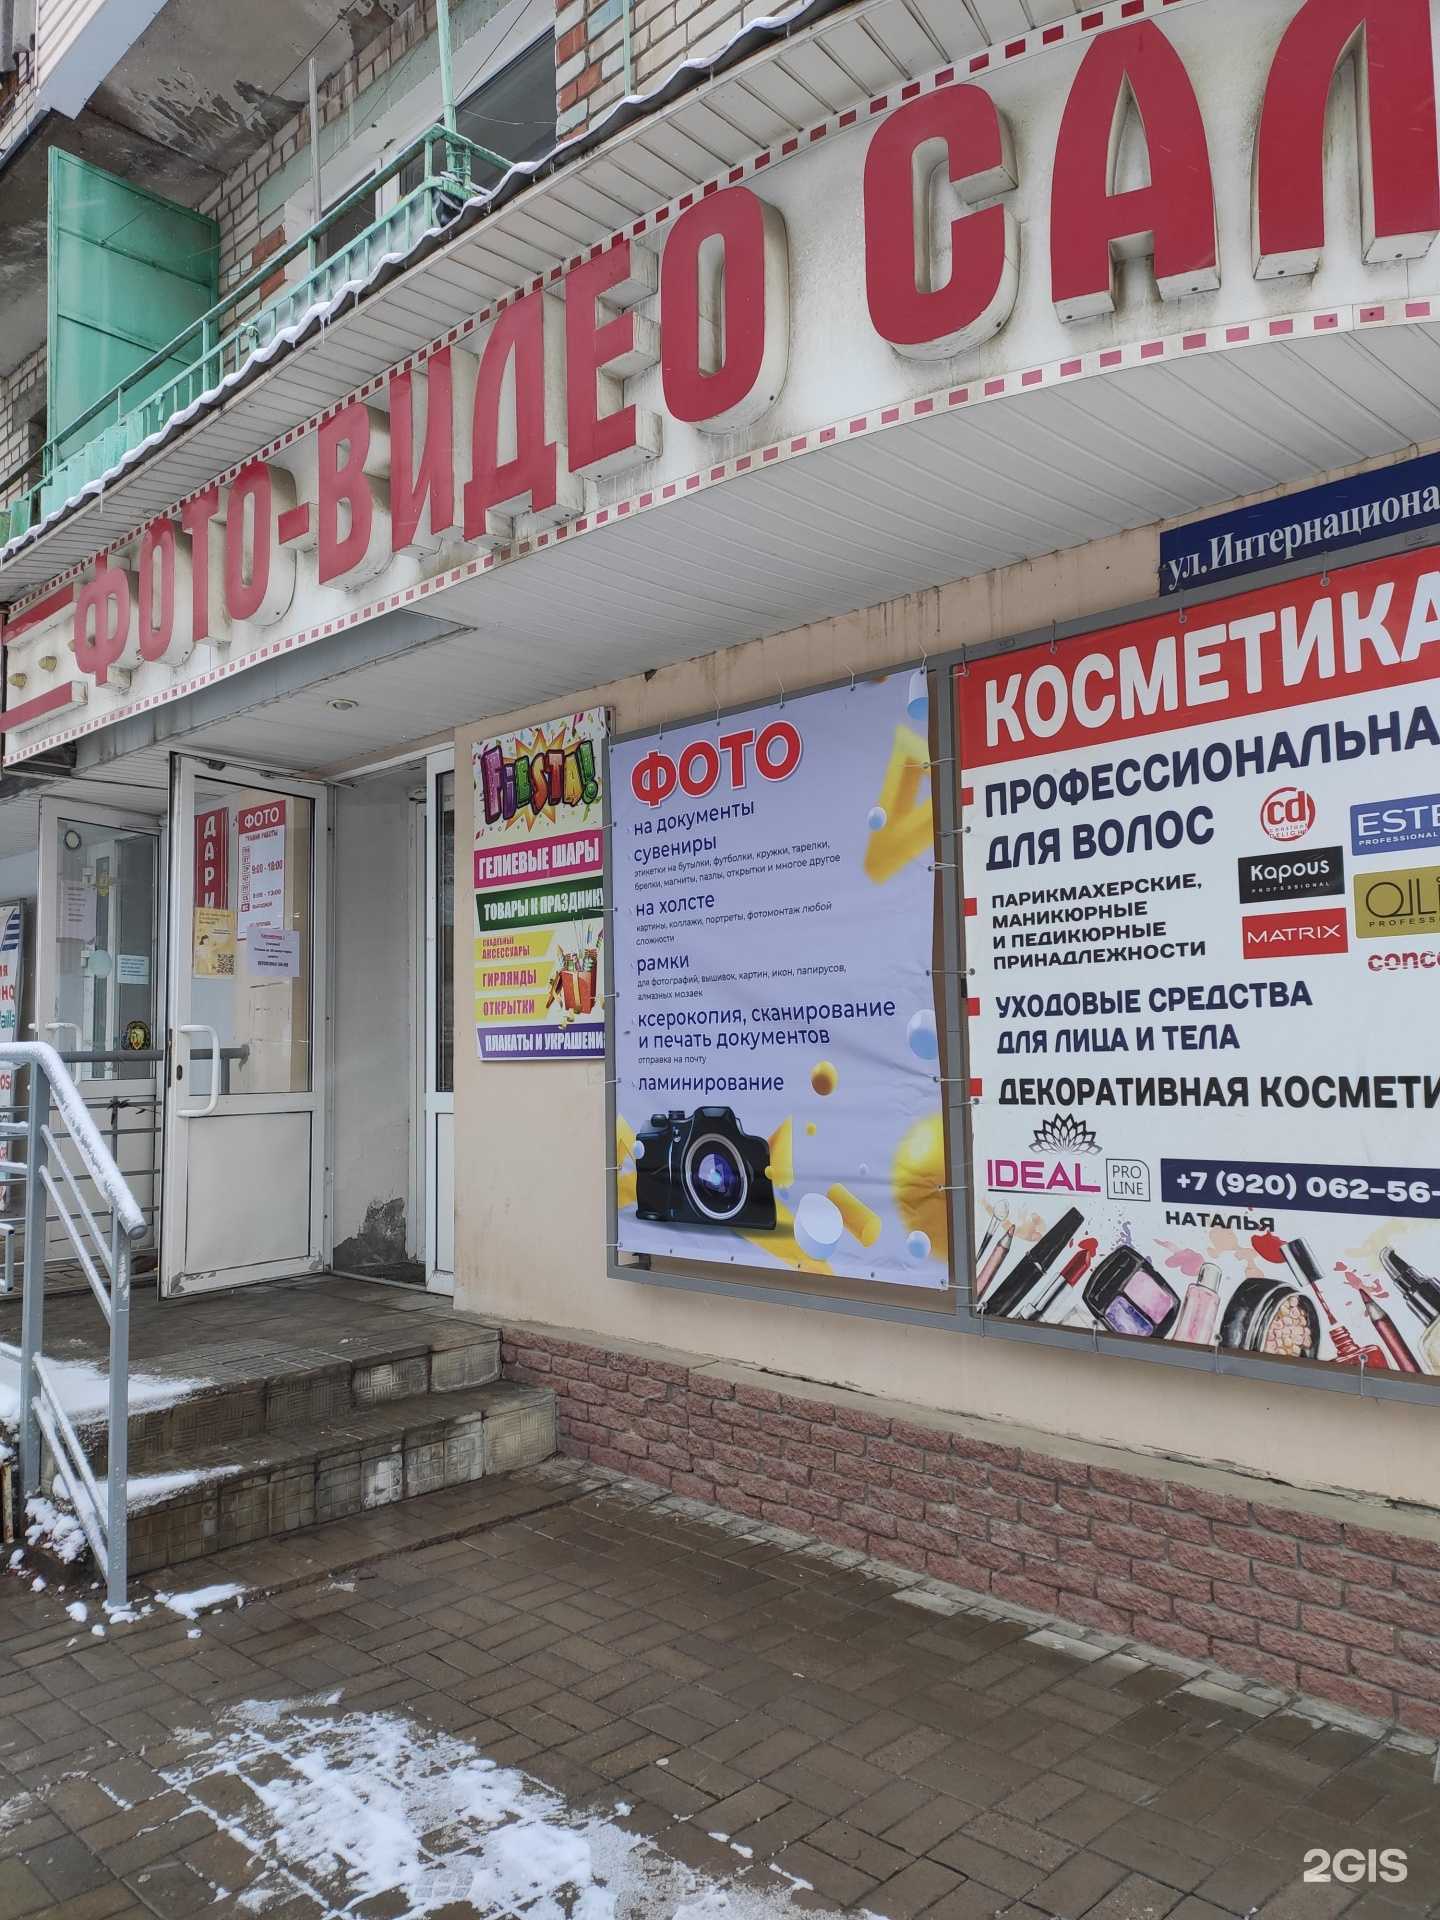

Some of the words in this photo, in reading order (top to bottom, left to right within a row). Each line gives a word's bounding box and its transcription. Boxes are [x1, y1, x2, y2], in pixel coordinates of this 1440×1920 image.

[74, 186, 766, 690] ФОТО-ВИДЕО
[985, 571, 1440, 748] КОСМЕТИКА
[631, 720, 802, 808] ФОТО
[985, 705, 1440, 818] ПРОФЕССИОНАЛЬНА
[244, 807, 280, 828] ФОТО
[634, 819, 653, 836] на
[657, 801, 755, 834] документы
[634, 836, 717, 865] сувениры
[986, 829, 1061, 872] ДЛЯ
[1073, 806, 1215, 861] ВОЛОС
[1359, 831, 1438, 846] PROFESSIONAL
[479, 847, 549, 880] ГЕЛИЕВЫЕ
[552, 838, 599, 868] ШАРЫ
[727, 864, 766, 880] открытки
[809, 853, 841, 868] другое
[1250, 860, 1330, 883] Kapous
[992, 873, 1202, 909] ПАРИКМАХЕРСКИЕ,
[484, 899, 529, 921] ТОВАРЫ
[636, 903, 655, 917] на
[659, 893, 715, 915] холсте
[705, 914, 746, 926] портреты,
[747, 906, 801, 921] фотомонтаж
[802, 901, 832, 913] любой
[992, 901, 1148, 928] МАНИКЮРНЫЕ
[636, 934, 675, 946] сложности
[993, 935, 1006, 949] И
[1011, 922, 1167, 949] ПЕДИКЮРНЫЕ
[1248, 924, 1341, 945] MATRIX
[637, 954, 689, 975] рамки
[993, 941, 1206, 970] ПРИНАДЛЕЖНОСТИ
[483, 969, 536, 987] ГИРЛЯНДЫ
[651, 974, 700, 987] фотографий,
[772, 968, 795, 979] икон,
[796, 963, 847, 977] папирусов,
[483, 1000, 535, 1016] ОТКРЫТКИ
[995, 989, 1141, 1018] УХОДОВЫЕ
[1149, 980, 1313, 1012] СРЕДСТВА
[638, 1007, 747, 1032] ксерокопия,
[751, 1000, 896, 1024] сканирование
[485, 1034, 533, 1052] ПЛАКАТЫ
[535, 1033, 543, 1051] И
[639, 1034, 648, 1049] и
[653, 1032, 712, 1048] печать
[716, 1027, 830, 1050] документов
[997, 1029, 1048, 1054] ДЛЯ
[1055, 1027, 1129, 1052] ЛИЦА
[1136, 1026, 1154, 1050] И
[1162, 1023, 1240, 1050] ТЕЛА
[638, 1056, 672, 1065] отправка
[685, 1054, 707, 1066] почту
[638, 1073, 784, 1095] ламинирование
[999, 1076, 1249, 1107] ДЕКОРАТИВНАЯ
[987, 1159, 1101, 1193] IDEAL
[1112, 1164, 1143, 1178] PRO
[1112, 1181, 1144, 1196] LINE
[1177, 1171, 1208, 1191] +7
[1216, 1170, 1297, 1200] (920)
[1166, 1210, 1275, 1232] НАТАЛЬЯ
